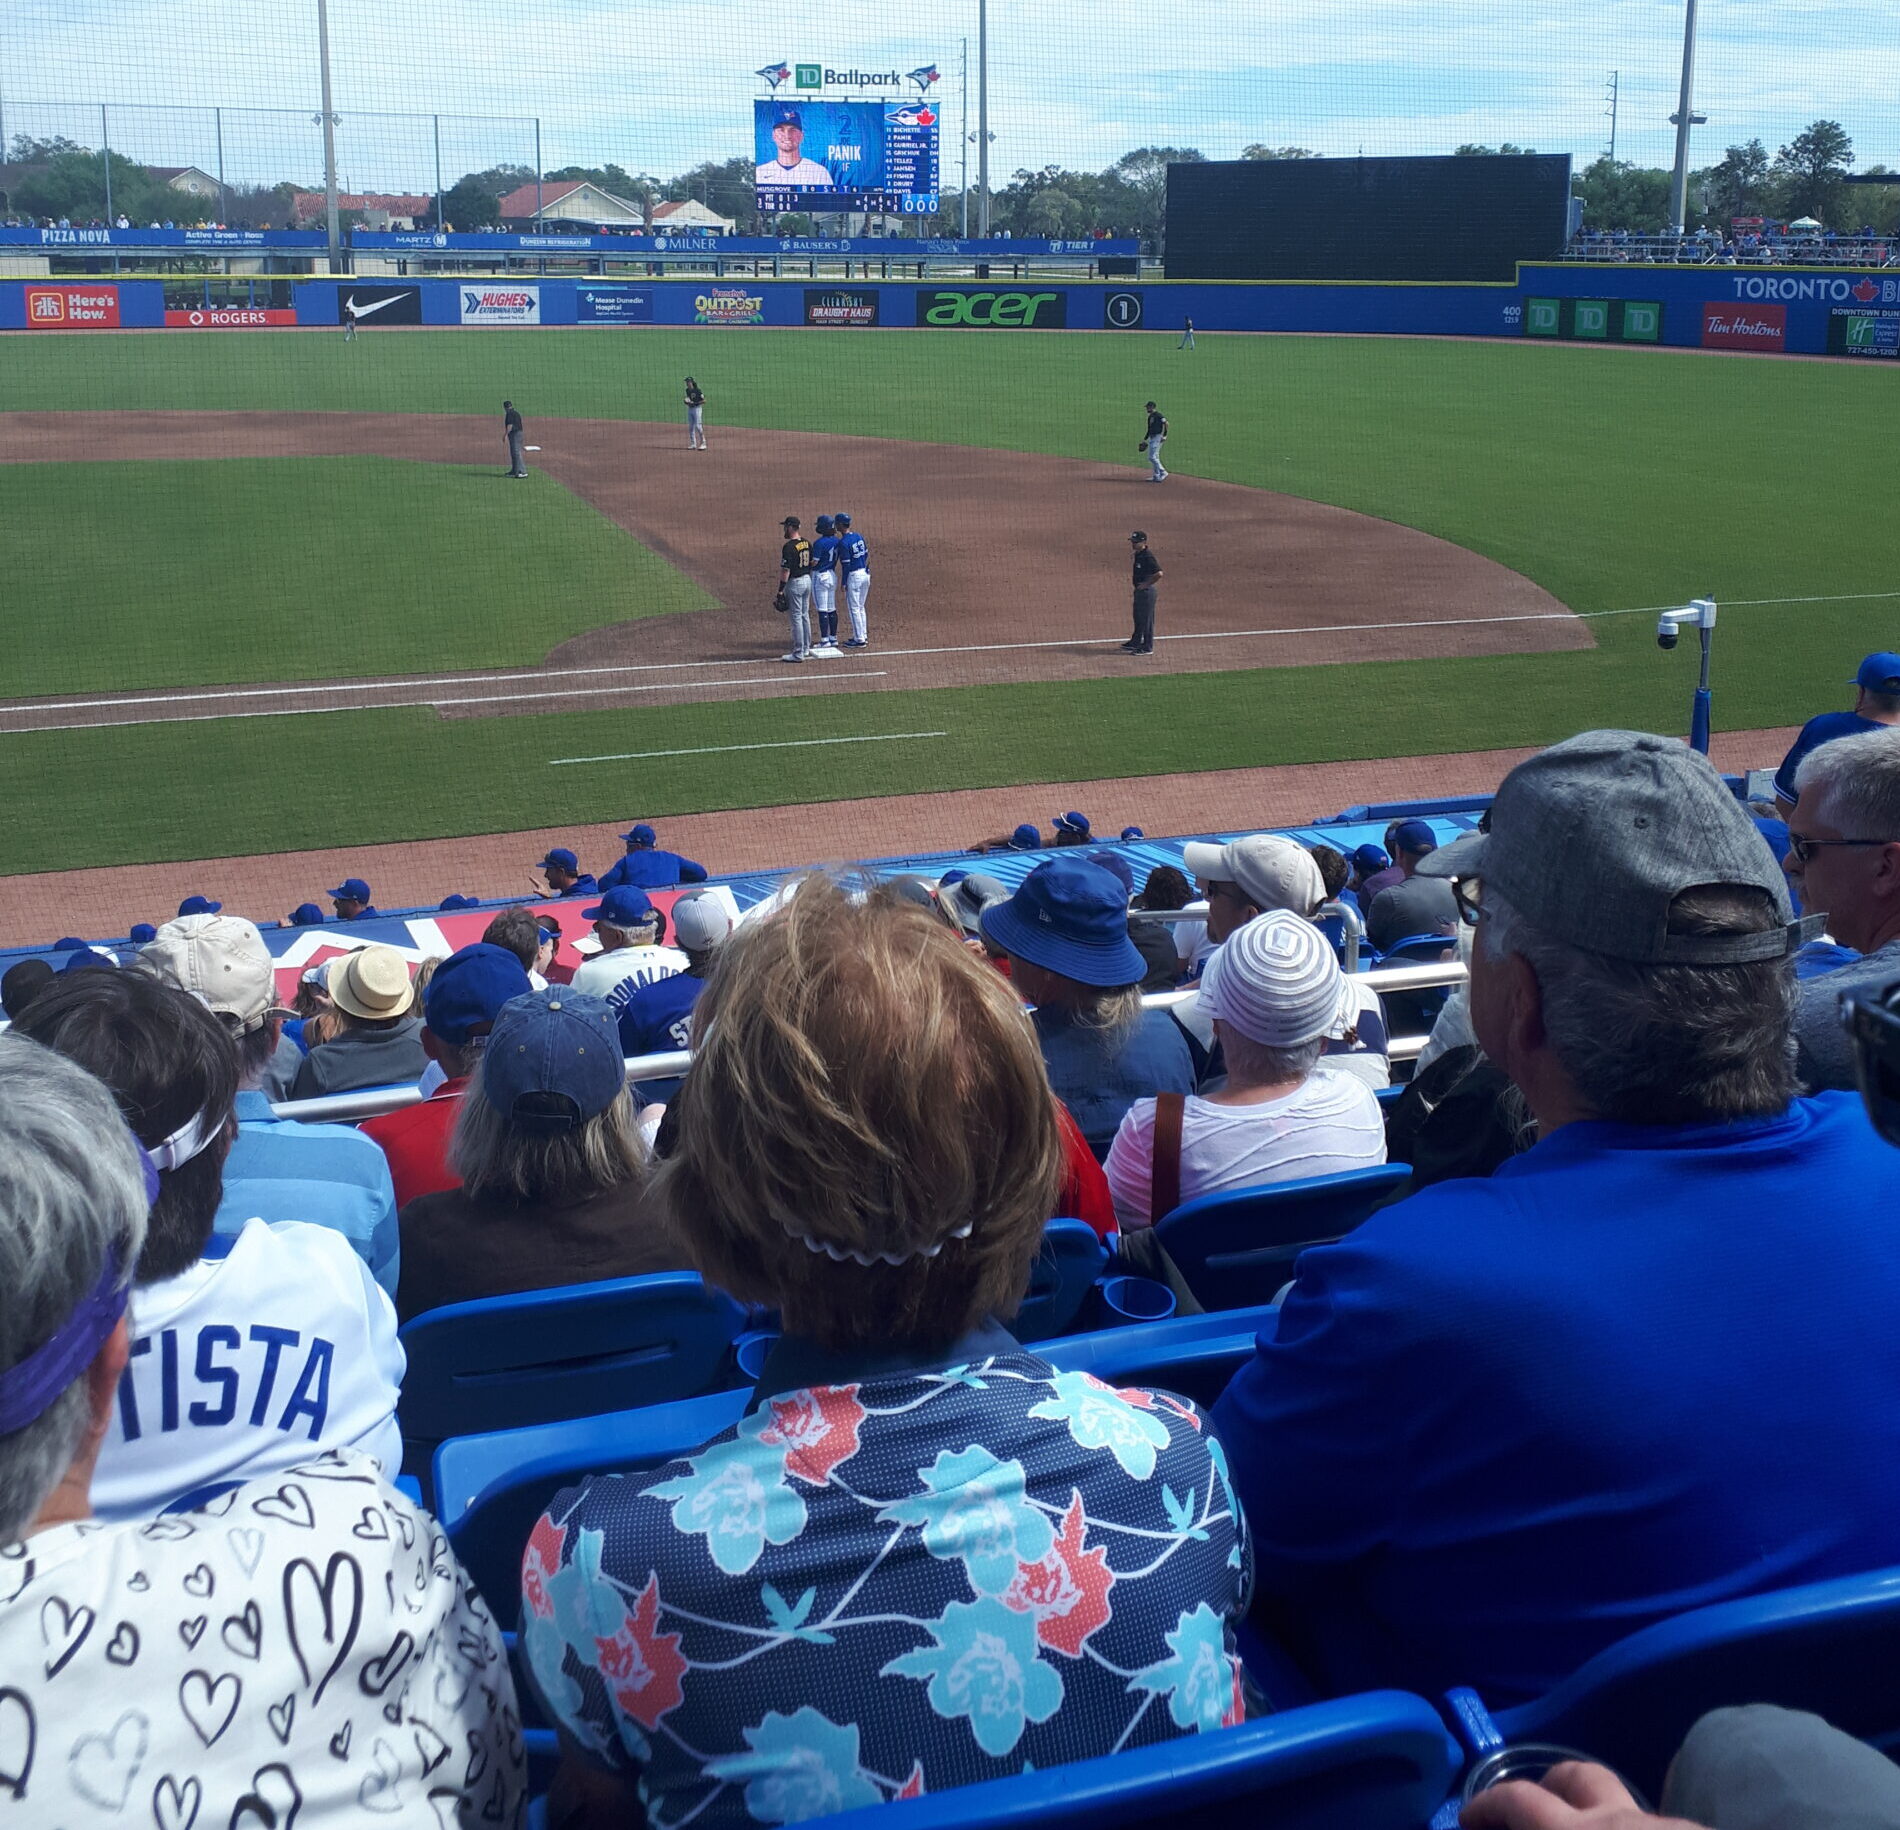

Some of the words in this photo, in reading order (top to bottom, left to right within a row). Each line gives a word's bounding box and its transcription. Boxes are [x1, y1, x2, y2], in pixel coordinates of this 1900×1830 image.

[798, 68, 820, 84] TD
[824, 69, 901, 88] Ballpark
[838, 114, 852, 135] 2
[828, 145, 862, 161] PANIK
[41, 229, 76, 243] PIZZA
[79, 229, 111, 244] NOVA
[185, 231, 212, 239] Active
[214, 231, 238, 239] Green
[244, 231, 265, 239] Ross
[395, 236, 432, 244] MARTZ
[669, 238, 718, 250] MILNER
[793, 241, 838, 249] BAUSER'S
[1065, 241, 1088, 249] TIER
[1089, 241, 1096, 249] 1
[1733, 277, 1850, 300] TORONTO
[1881, 280, 1900, 302] B
[68, 294, 115, 307] Here's
[480, 292, 528, 307] HUGHES
[695, 295, 764, 312] OUTPOST
[69, 307, 107, 320] How.
[595, 304, 622, 312] Hospital
[812, 307, 850, 317] DRAUGHT
[849, 308, 872, 317] HAUS
[926, 292, 1057, 325] acer
[1502, 306, 1521, 316] 400
[1831, 308, 1880, 317] DOWNTOWN
[210, 312, 267, 324] ROGERS
[1531, 304, 1557, 328] TD
[1579, 307, 1604, 330] TD
[1628, 309, 1655, 333] TD
[1707, 316, 1730, 334] Tim
[1730, 316, 1782, 337] Hortons
[852, 539, 866, 559] 53
